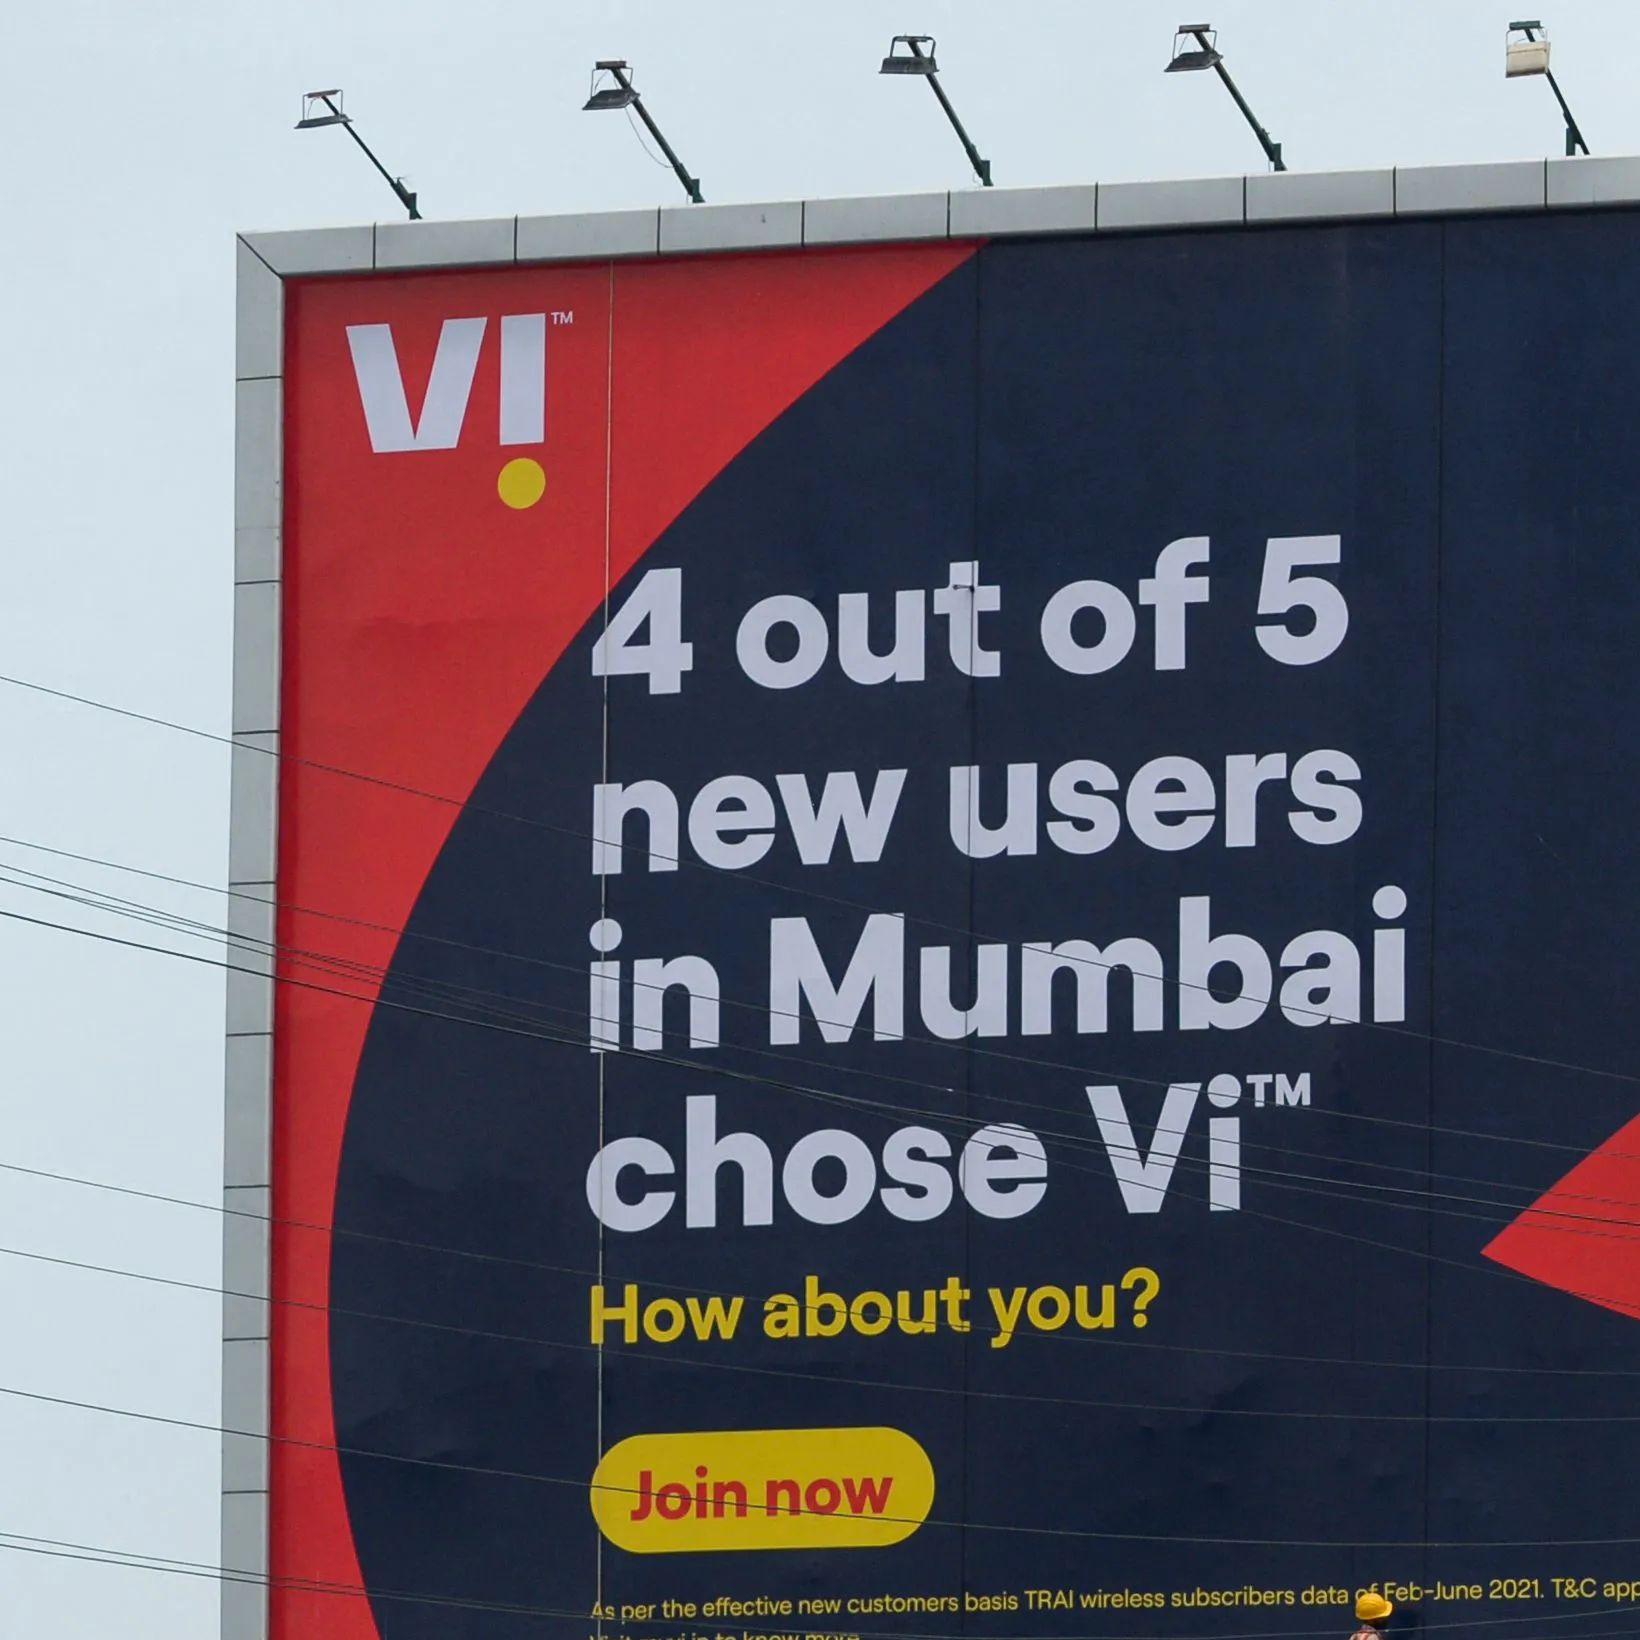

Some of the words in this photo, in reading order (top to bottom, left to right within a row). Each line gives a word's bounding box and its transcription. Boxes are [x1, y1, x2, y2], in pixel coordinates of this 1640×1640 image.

[592, 567, 693, 695] 4
[736, 560, 1001, 689] out
[1040, 536, 1210, 675] of
[1255, 535, 1350, 665] 5
[592, 769, 908, 875] new
[950, 748, 1363, 859] users
[589, 918, 720, 1053] in
[770, 885, 1407, 1045] Mumbai
[586, 1095, 1048, 1232] chose
[590, 1283, 744, 1345] How
[763, 1275, 971, 1339] about
[988, 1267, 1160, 1349] you?
[630, 1465, 747, 1521] Join
[766, 1476, 893, 1517] now
[591, 1600, 615, 1620] As
[621, 1602, 655, 1625] per
[662, 1599, 696, 1618] the
[703, 1595, 792, 1616] effective
[798, 1599, 840, 1614] new
[847, 1593, 959, 1612] customers
[965, 1591, 1019, 1611] basis
[1024, 1590, 1073, 1610] TRAI
[1080, 1588, 1165, 1609] wireless
[1171, 1586, 1295, 1607] subscribers
[1302, 1586, 1349, 1604] data
[1385, 1580, 1483, 1600] Feb-June
[1489, 1579, 1544, 1599] 2021.
[1552, 1578, 1598, 1598] T&C
